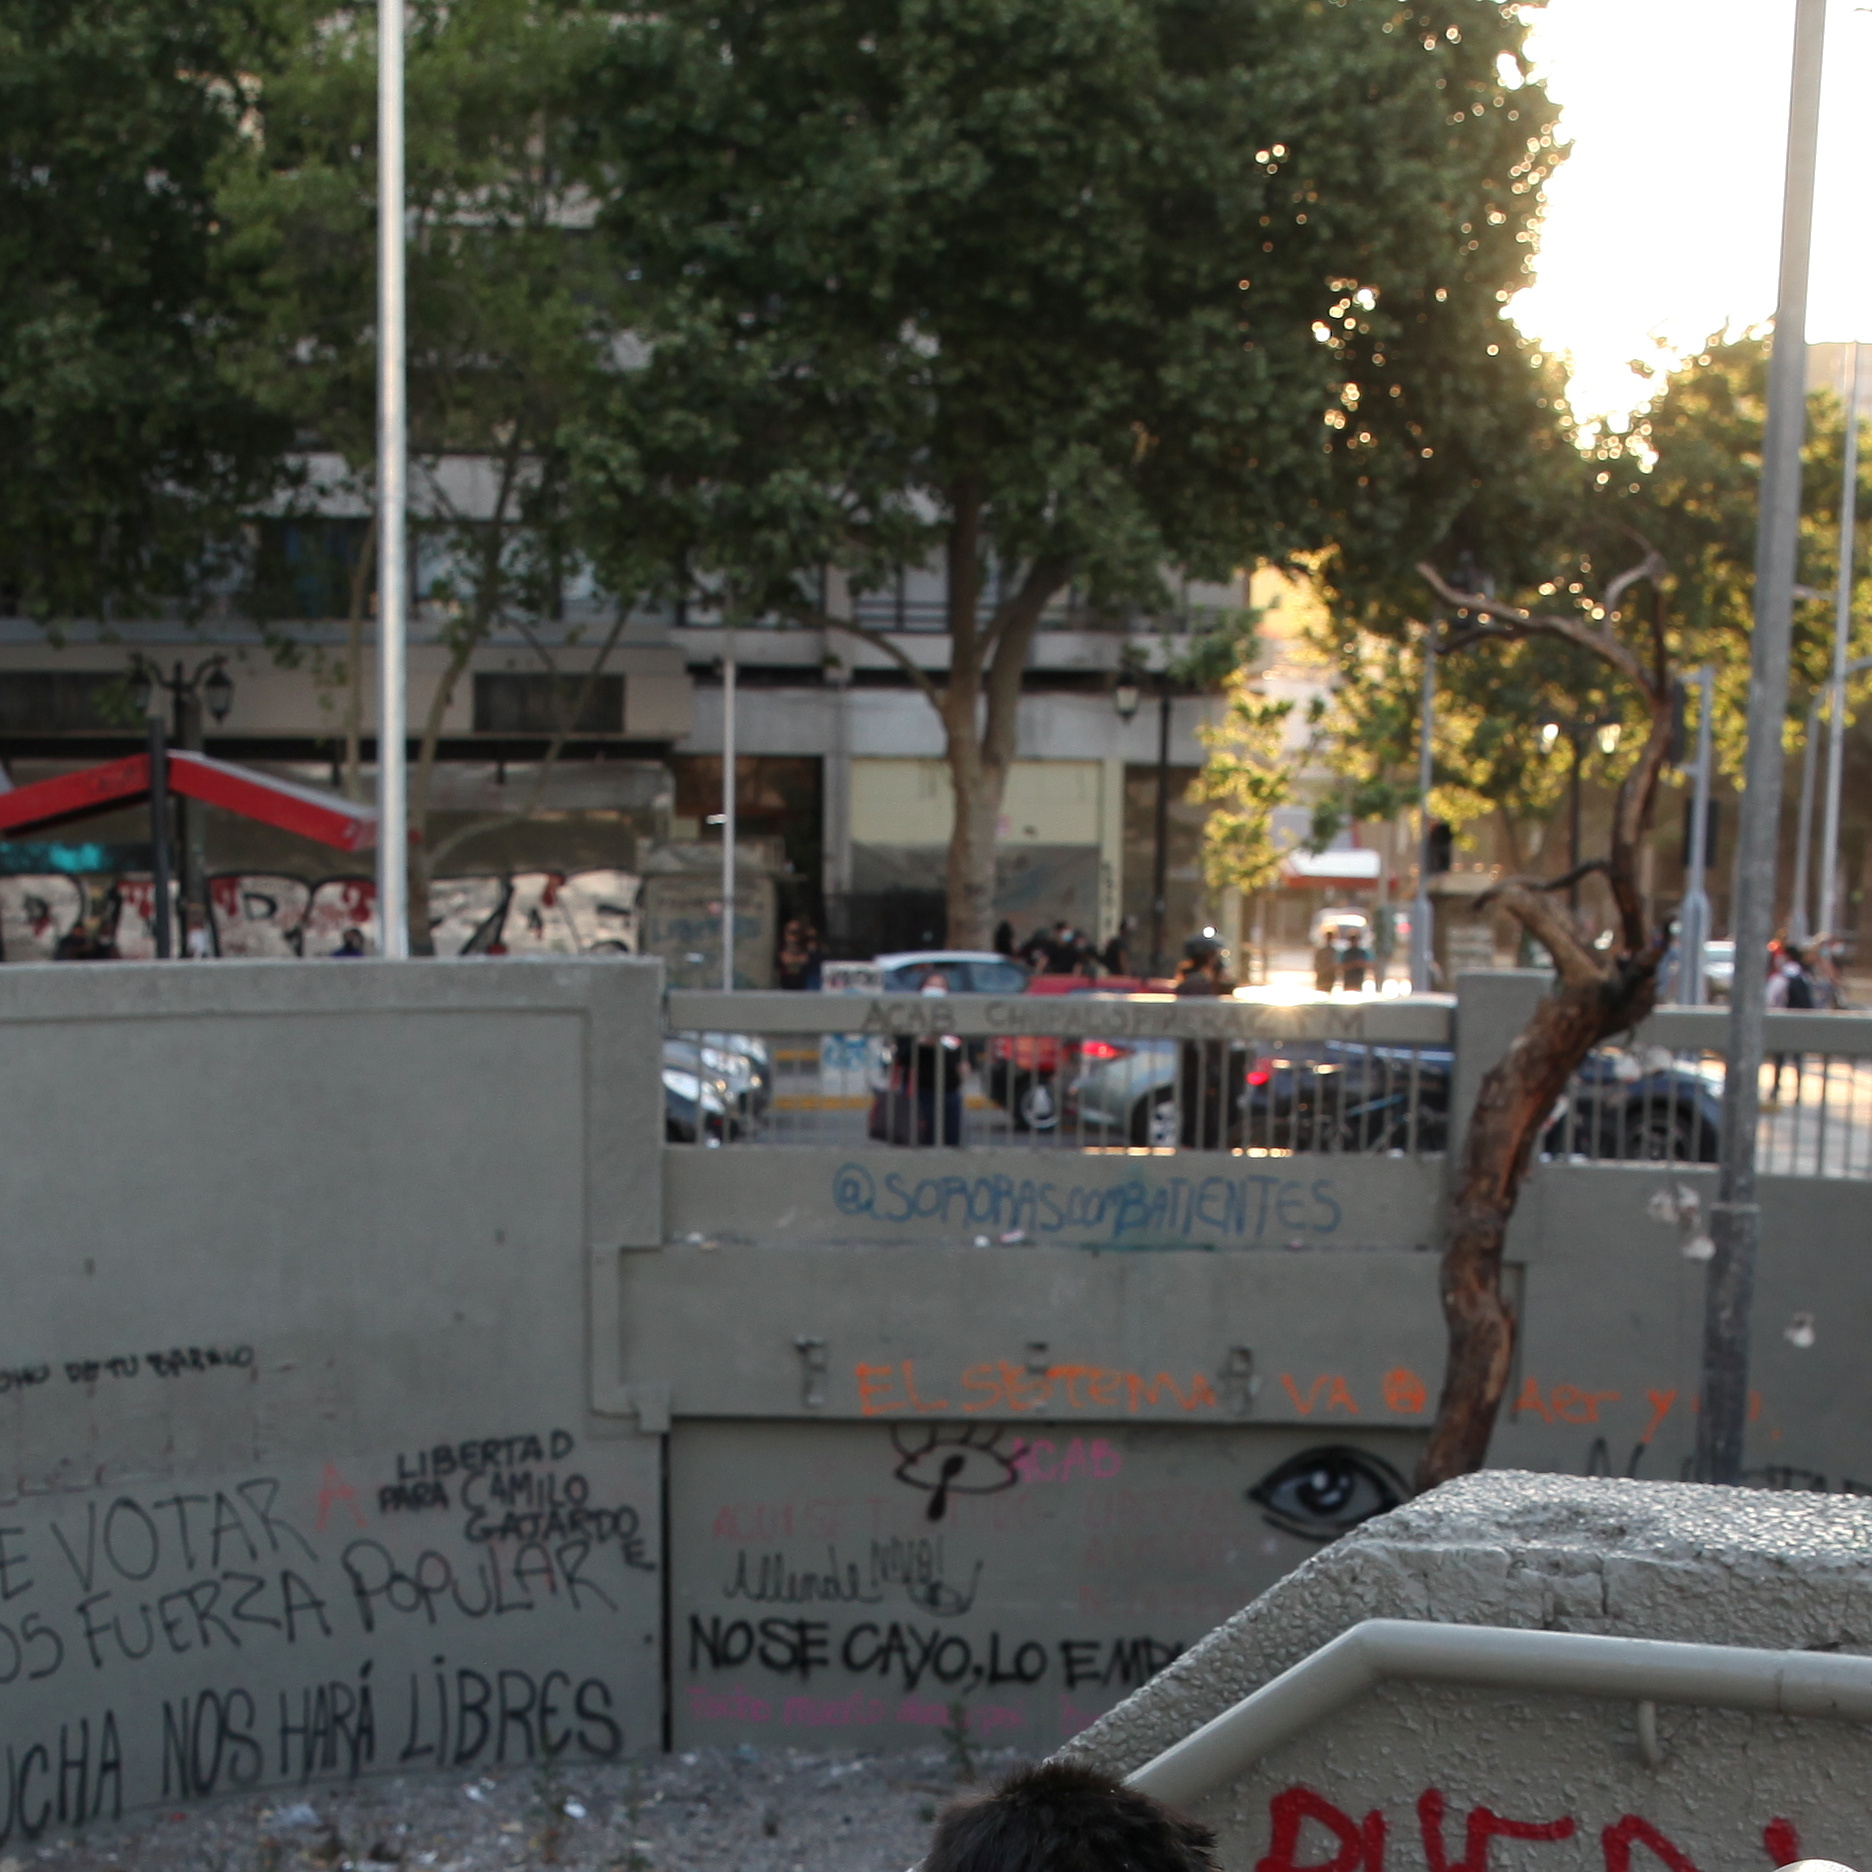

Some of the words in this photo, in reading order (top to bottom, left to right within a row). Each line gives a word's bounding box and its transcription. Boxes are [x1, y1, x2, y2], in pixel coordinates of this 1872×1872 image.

[1281, 1373, 1362, 1416] VA
[396, 1430, 574, 1480] LIBERTAD
[461, 1472, 589, 1512] CAMILO
[49, 1477, 320, 1592] VOTAR
[76, 1567, 332, 1670] FUERZA
[341, 1537, 618, 1633] POPULAR
[161, 1687, 264, 1800] NOS
[398, 1654, 624, 1768] LIBRES
